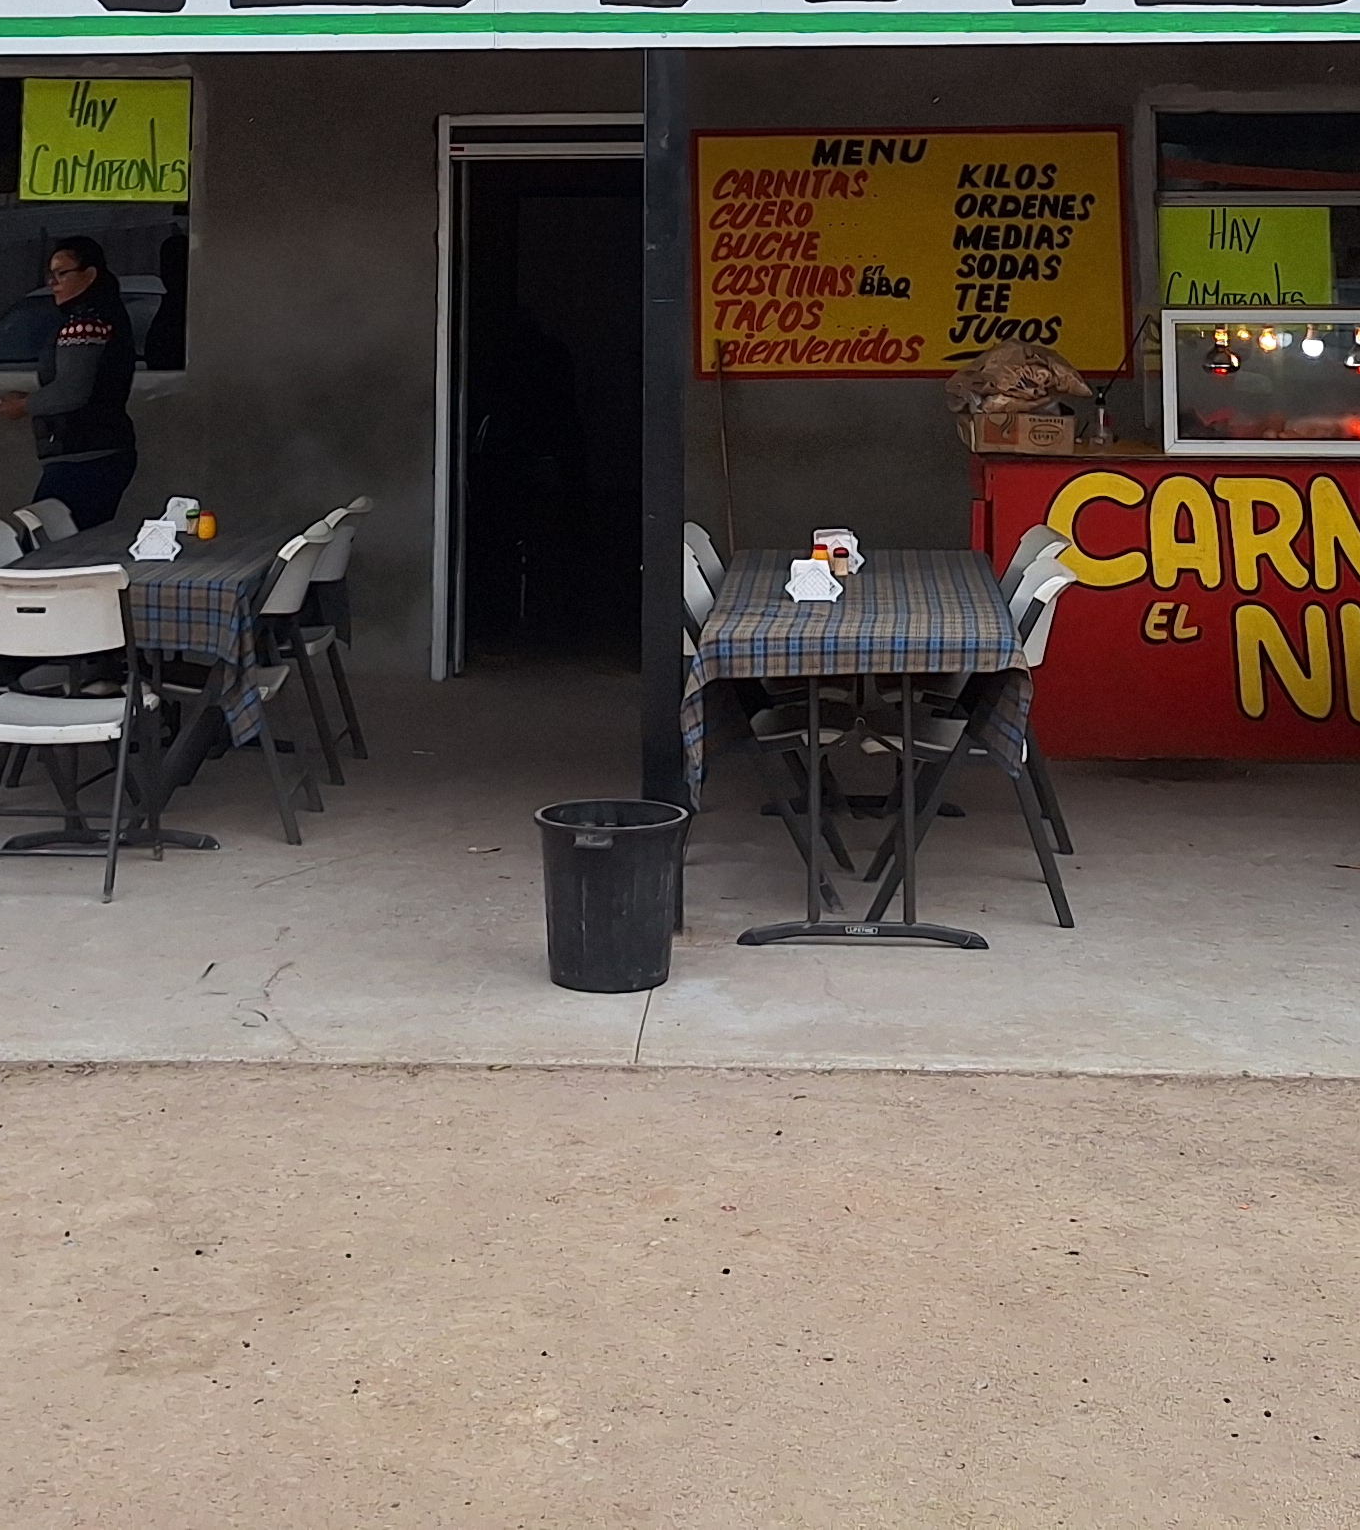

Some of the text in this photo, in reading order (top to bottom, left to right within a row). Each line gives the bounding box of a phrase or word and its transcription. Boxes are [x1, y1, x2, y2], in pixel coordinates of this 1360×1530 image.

[67, 80, 118, 133] HAY
[28, 118, 187, 196] CAMARONES
[811, 138, 928, 167] MENU
[711, 168, 870, 201] CARNITAS
[956, 163, 1058, 190] KILOS
[708, 199, 815, 231] CUERO
[953, 193, 1096, 221] ORDENES
[710, 230, 821, 263] BUCHE
[952, 223, 1074, 251] MEDIAS
[1208, 207, 1261, 254] HAY
[955, 252, 1062, 281] SODAS
[858, 276, 911, 301] BBQ
[954, 283, 1012, 314] TEE
[713, 298, 825, 333] TACOS
[711, 327, 926, 370] Bienvenidos
[1143, 600, 1202, 644] EL
